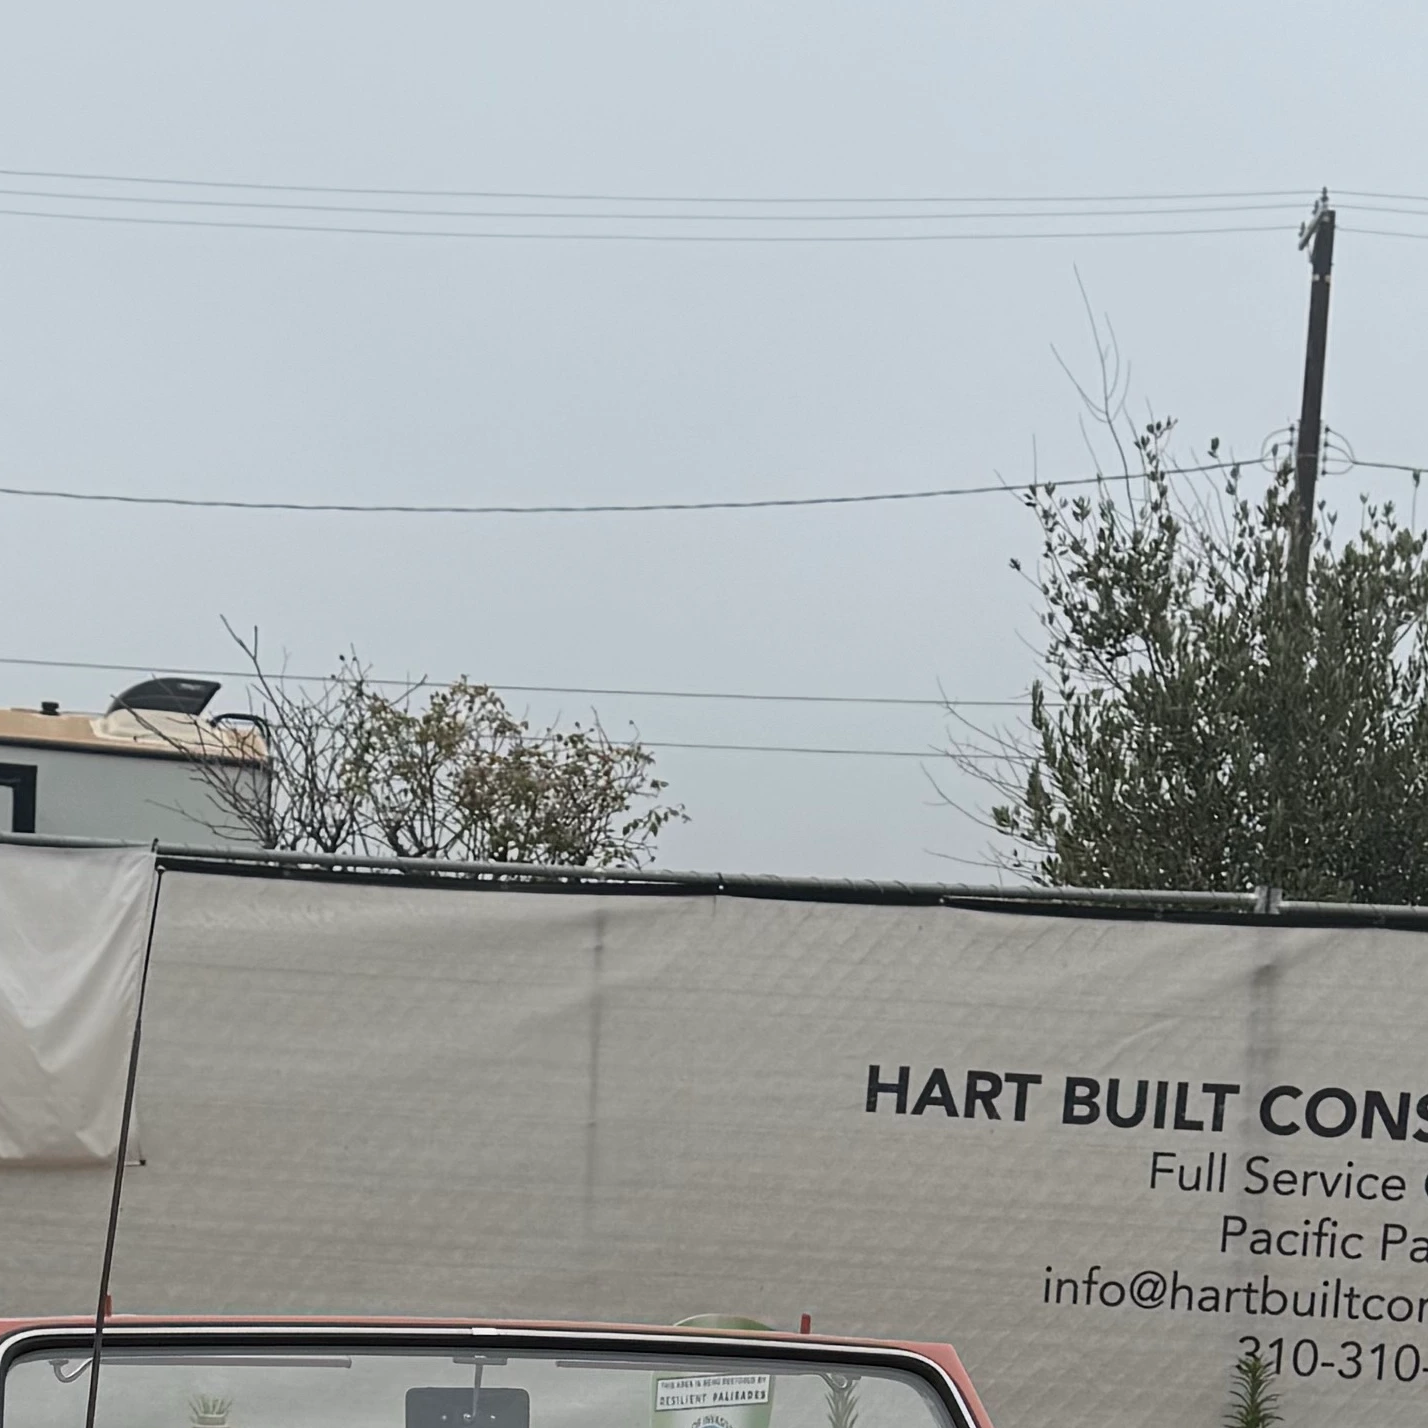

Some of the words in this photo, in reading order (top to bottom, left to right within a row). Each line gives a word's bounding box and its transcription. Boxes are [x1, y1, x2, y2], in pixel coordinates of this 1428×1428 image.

[865, 1064, 1043, 1123] HART
[1061, 1074, 1241, 1134] BUILT
[1149, 1150, 1228, 1196] Full
[1243, 1155, 1407, 1204] Service
[1220, 1214, 1364, 1264] Pacific
